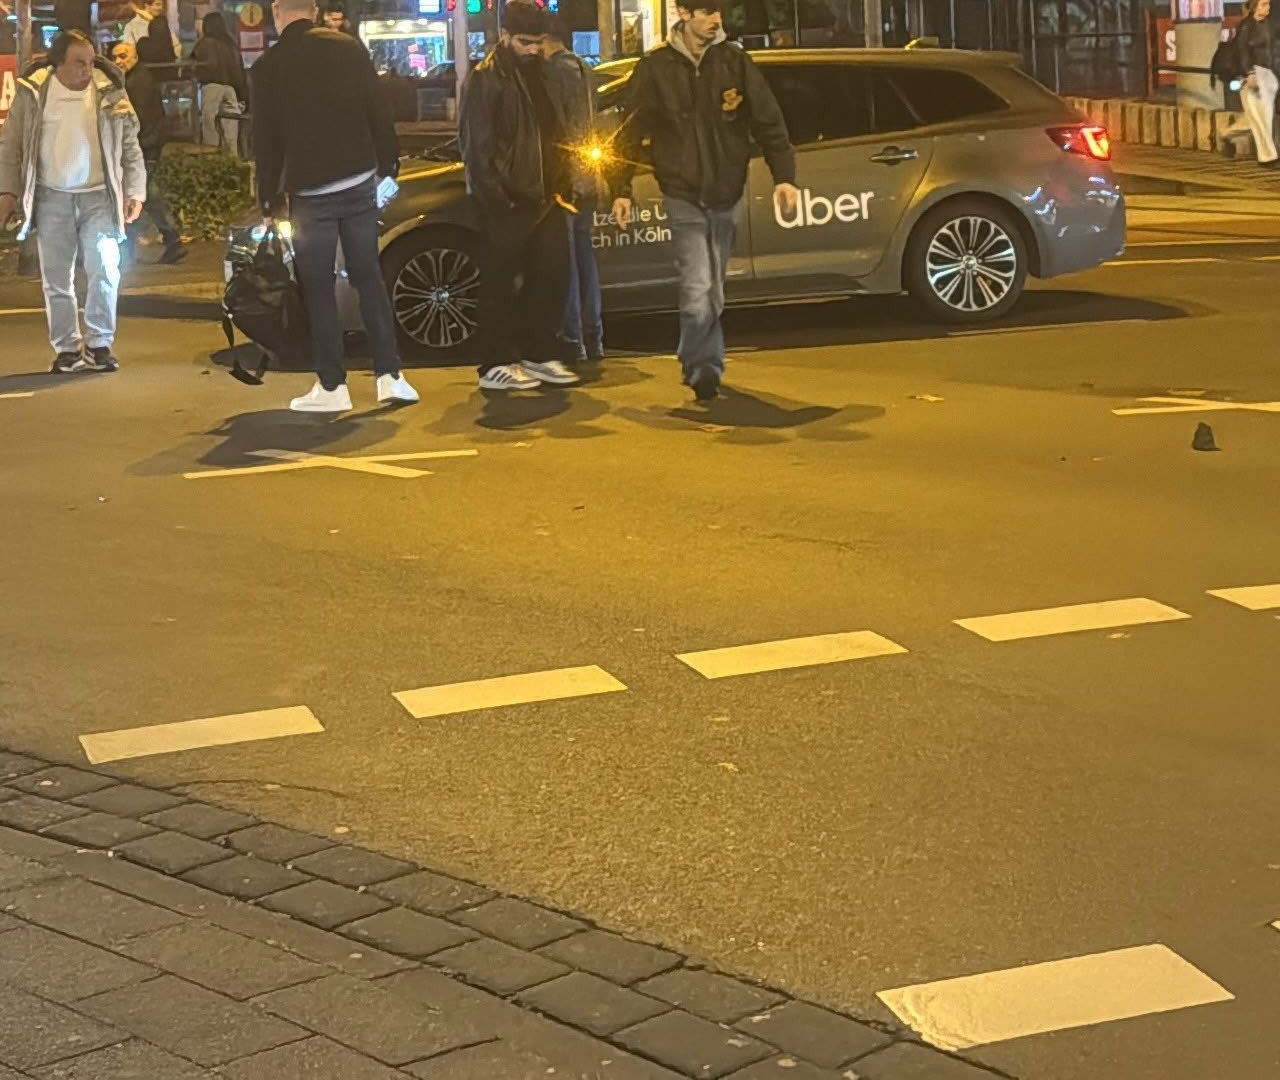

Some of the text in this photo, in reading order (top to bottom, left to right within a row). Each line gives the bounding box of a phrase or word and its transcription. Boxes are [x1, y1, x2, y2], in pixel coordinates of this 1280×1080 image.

[773, 188, 875, 229] Uber
[615, 230, 631, 246] in
[634, 226, 672, 244] Köln
